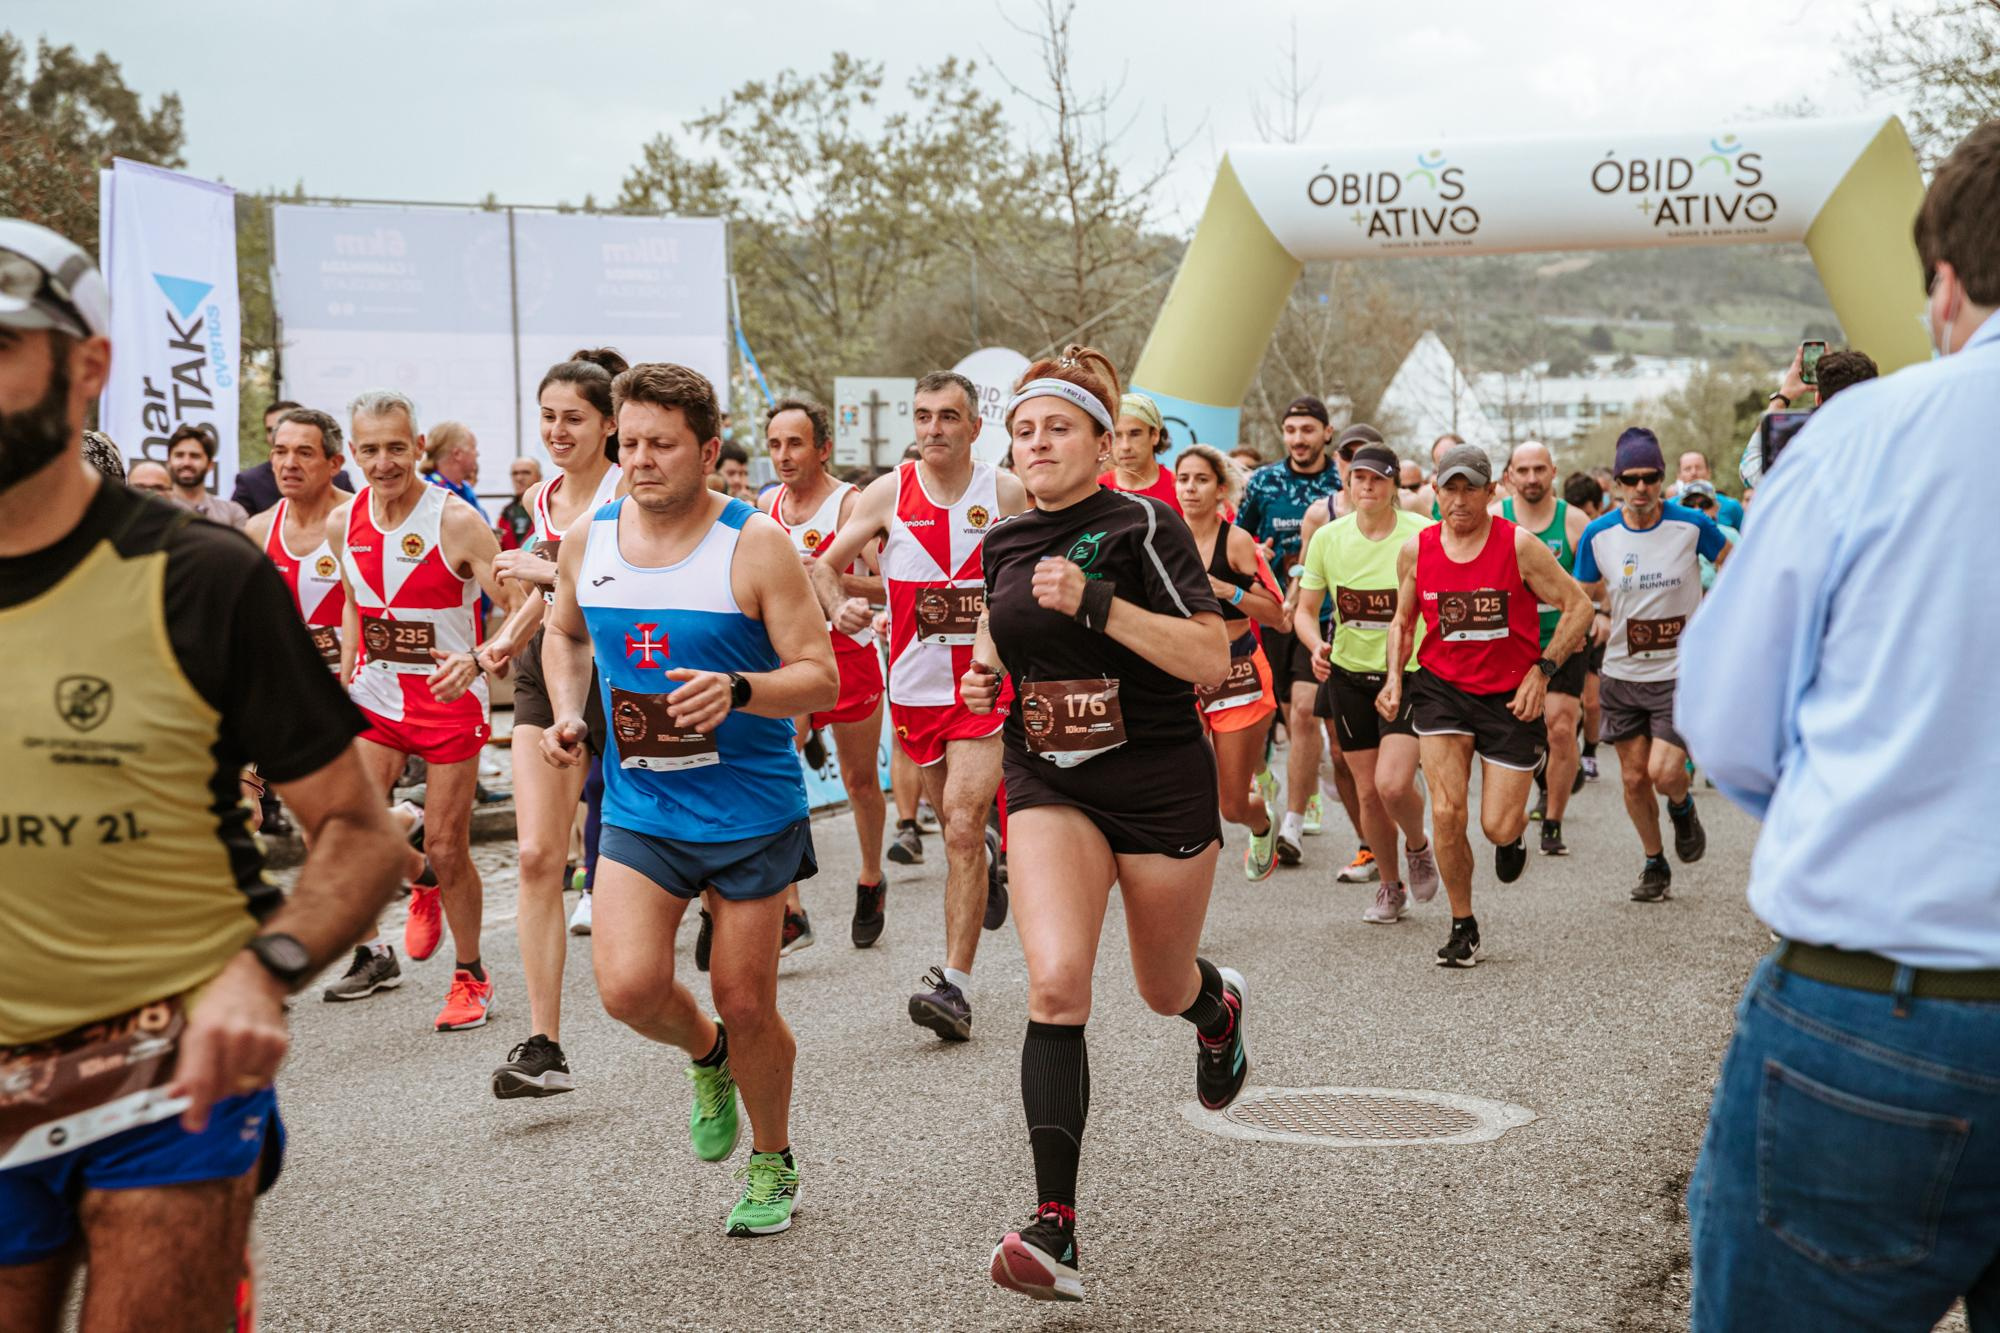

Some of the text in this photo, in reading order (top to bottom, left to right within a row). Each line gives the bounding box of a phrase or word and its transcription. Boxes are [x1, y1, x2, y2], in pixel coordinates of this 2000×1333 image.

[1639, 577, 1682, 591] RUNNERS
[1640, 572, 1663, 582] BEER
[958, 595, 983, 612] 116
[1367, 594, 1391, 608] 141
[1473, 597, 1502, 613] 125
[394, 627, 429, 645] 235
[1657, 622, 1681, 636] 129
[1063, 693, 1107, 718] 176
[1065, 725, 1087, 734] 10km
